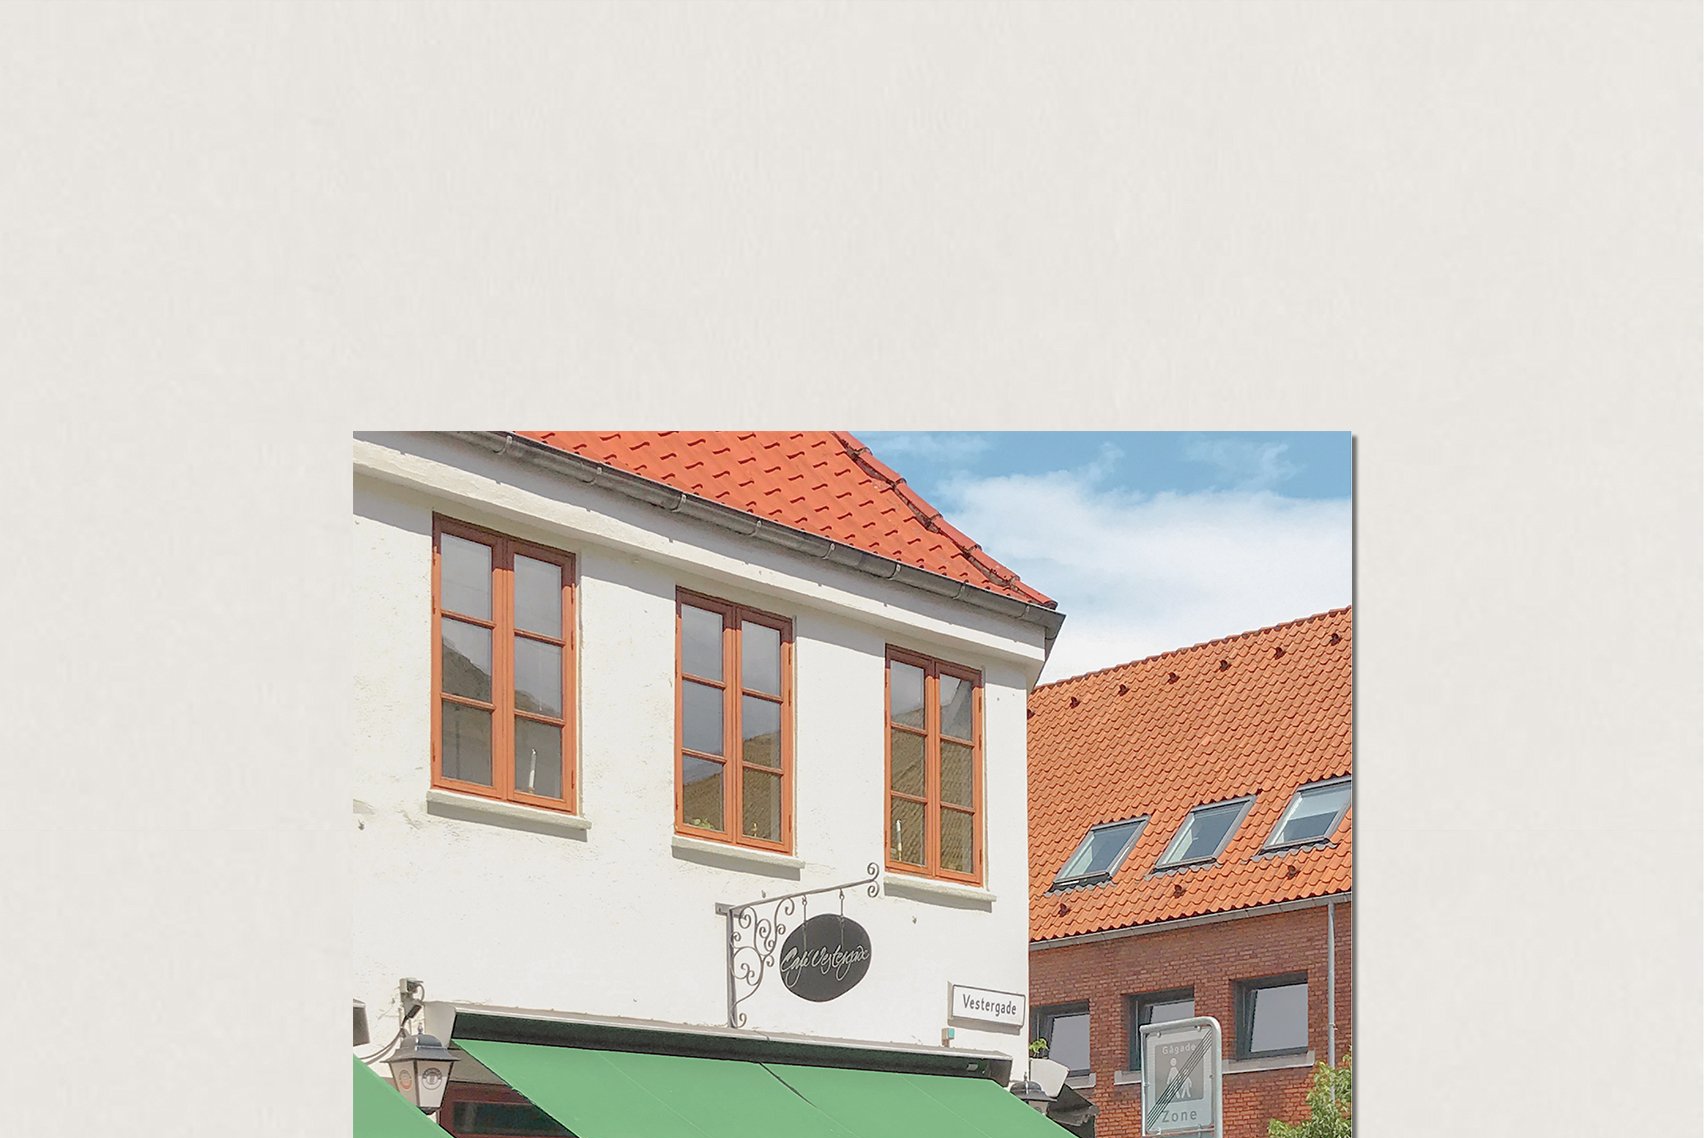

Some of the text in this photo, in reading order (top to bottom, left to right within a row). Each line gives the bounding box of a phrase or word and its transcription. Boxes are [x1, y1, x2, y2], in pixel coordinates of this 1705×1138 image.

[962, 993, 1017, 1017] Vestergade
[1161, 1042, 1197, 1055] Gågade
[1161, 1109, 1198, 1123] Zone
